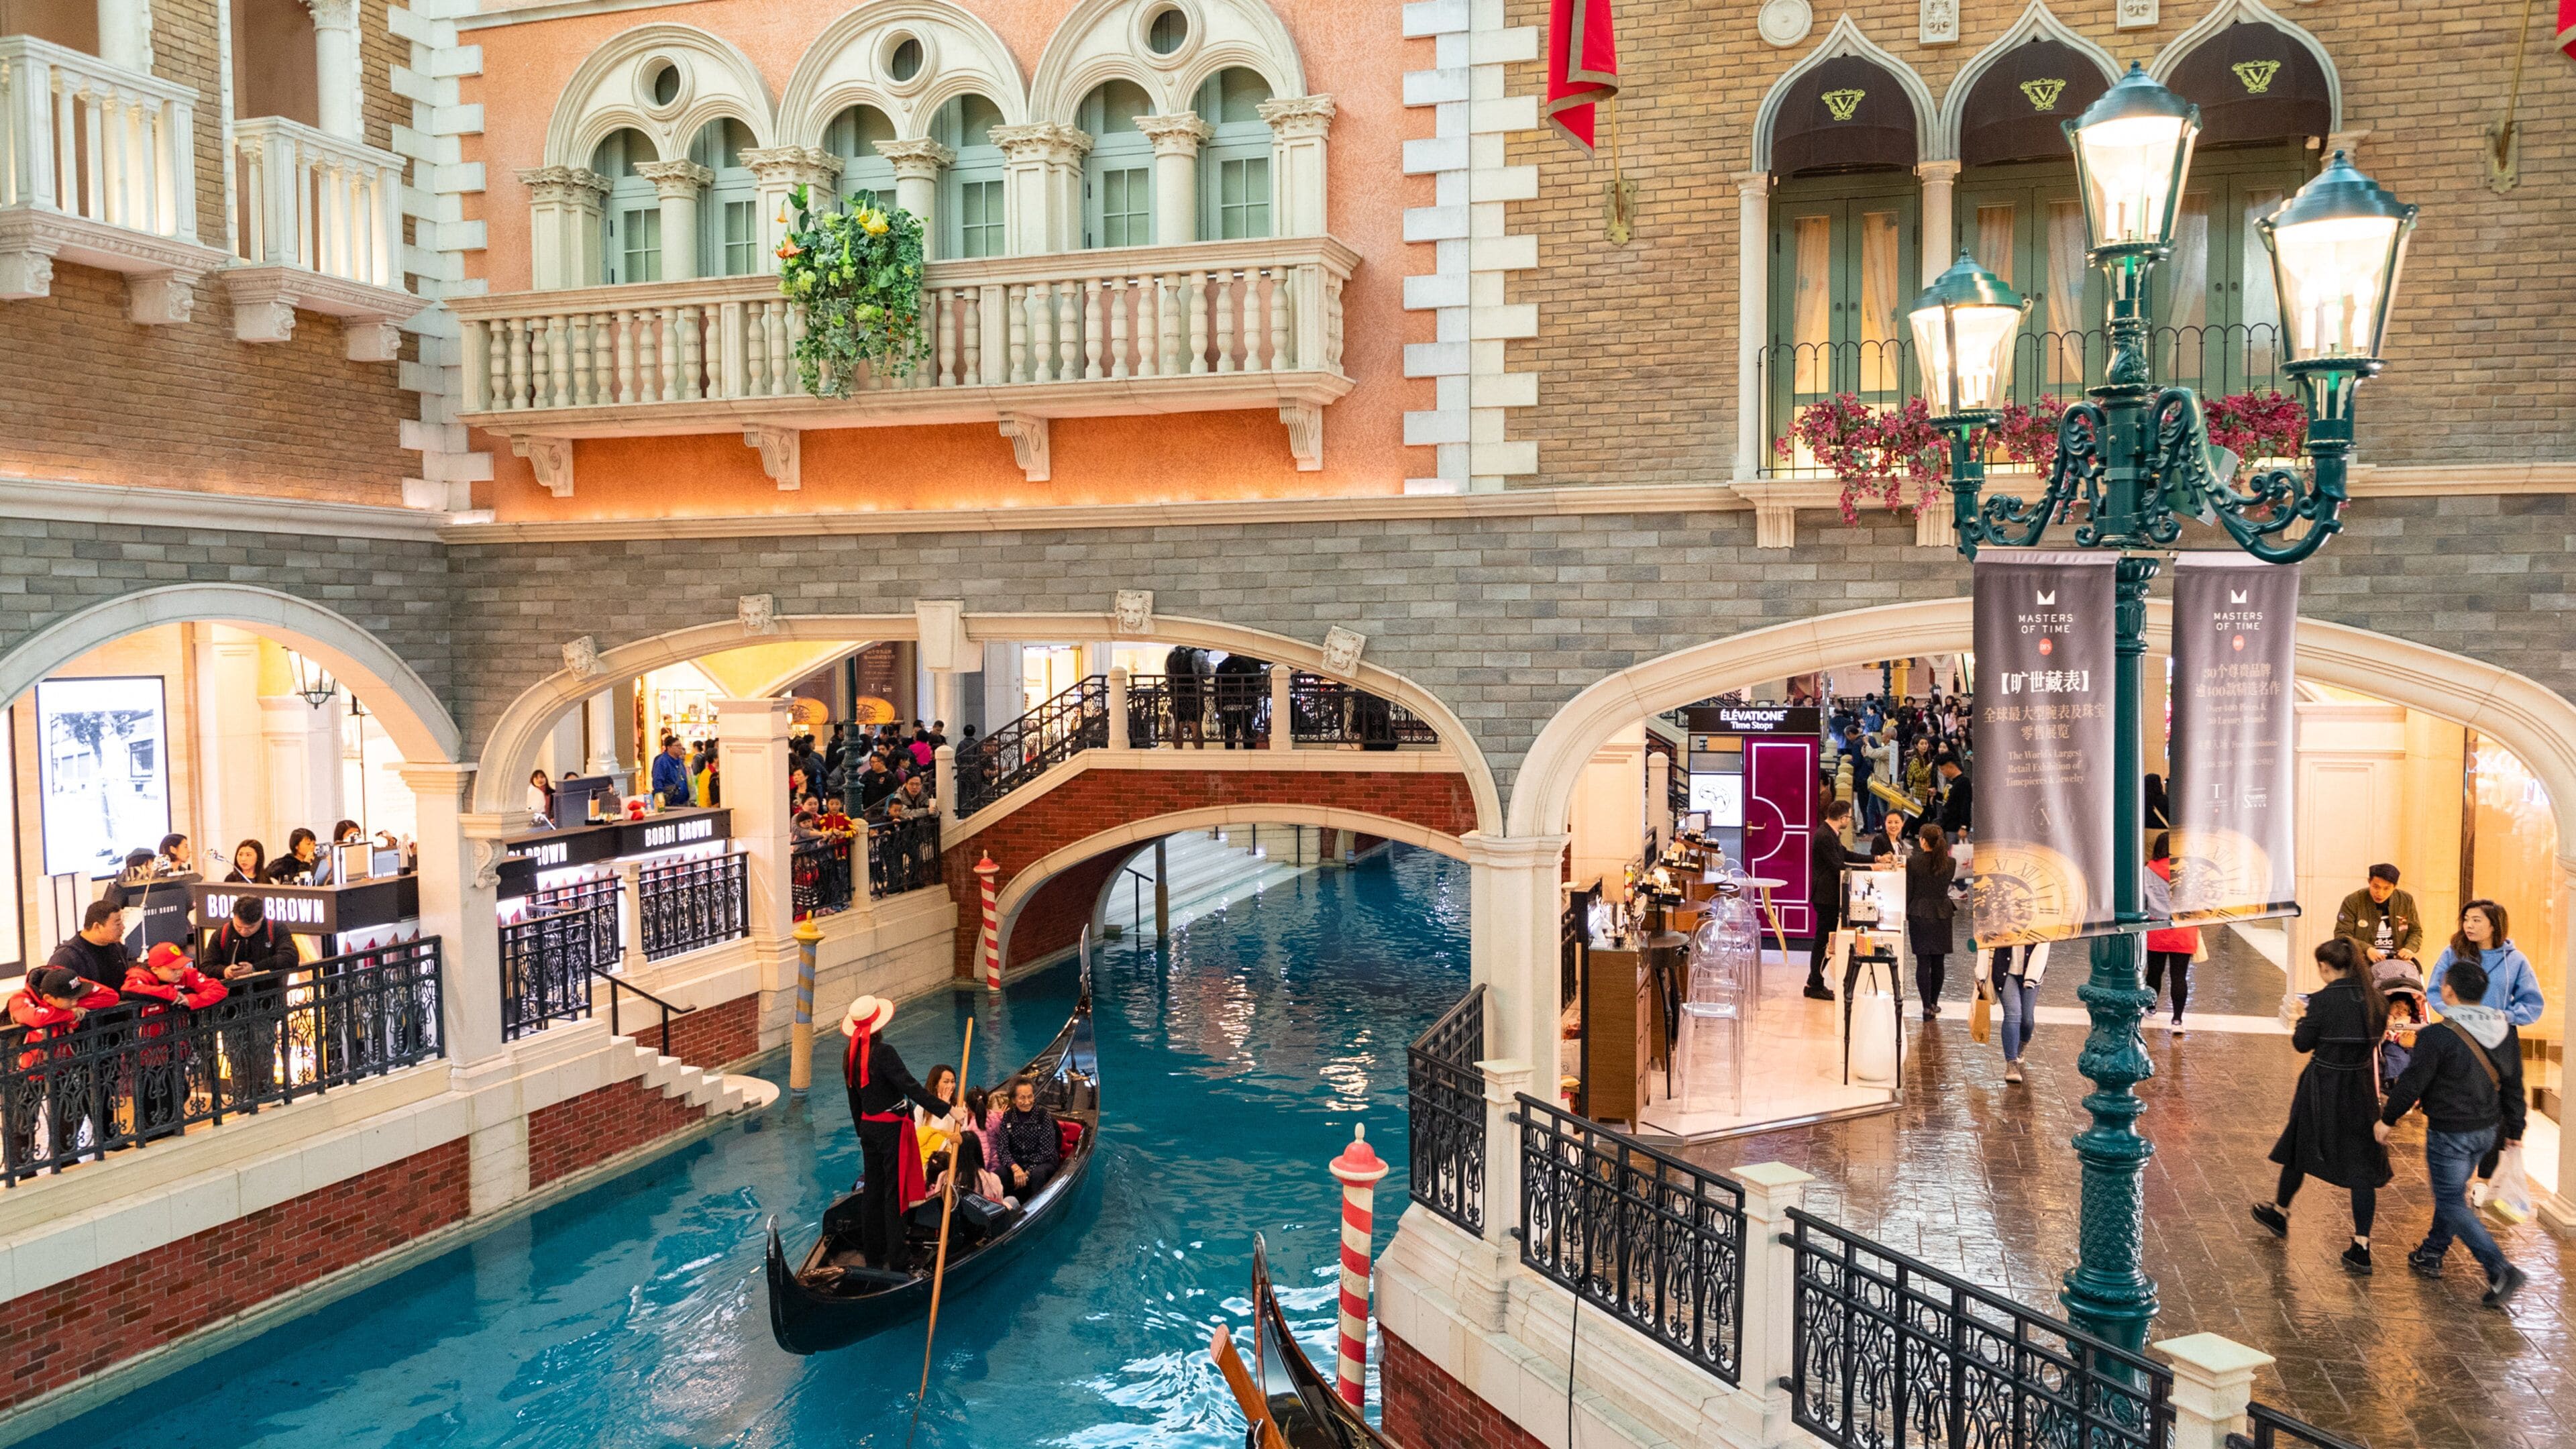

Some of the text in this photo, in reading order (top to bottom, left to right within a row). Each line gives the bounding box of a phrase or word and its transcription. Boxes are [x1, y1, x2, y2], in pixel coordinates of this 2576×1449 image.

[2018, 613, 2074, 623] MASTERS
[2214, 612, 2263, 621] MASTERS
[2021, 625, 2071, 634] OF TIME
[2216, 622, 2260, 631] OF TIME
[1730, 721, 1774, 731] Time Stops
[2008, 751, 2023, 760] The
[2054, 749, 2082, 759] Largest
[2008, 760, 2083, 773] Retail Exhibition of
[2005, 776, 2047, 788] Timepieces
[2048, 775, 2054, 784] &
[645, 818, 712, 847] BOBBI BROWN
[264, 897, 325, 923] BROWN
